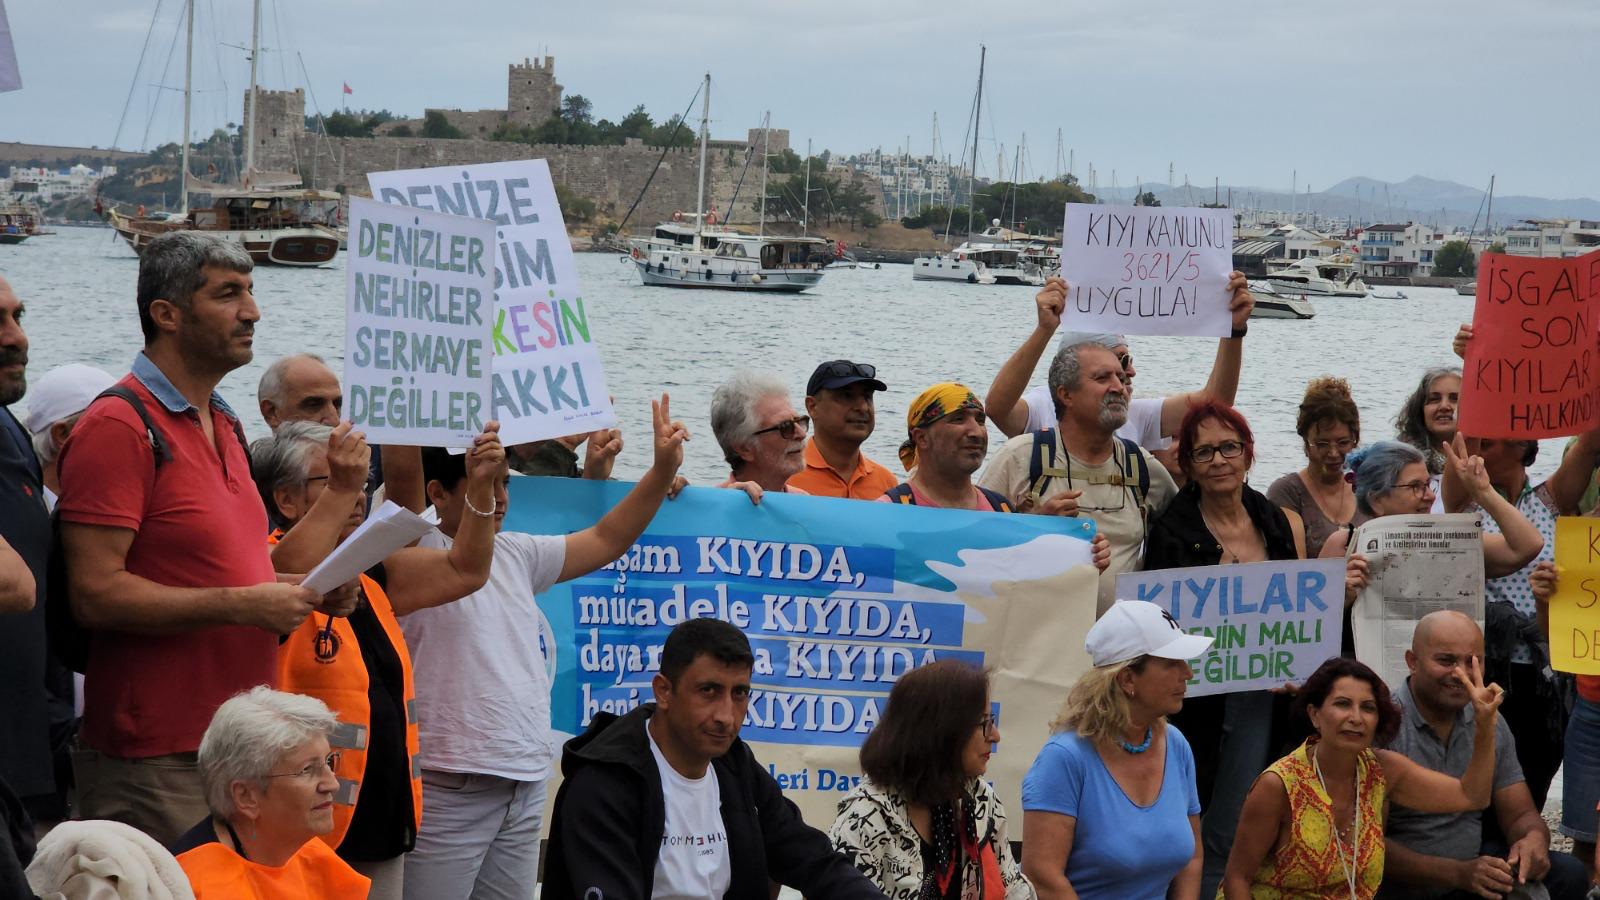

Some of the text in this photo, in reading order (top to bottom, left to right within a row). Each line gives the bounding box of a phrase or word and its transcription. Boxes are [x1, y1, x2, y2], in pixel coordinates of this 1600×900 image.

[358, 216, 486, 278] DENİZLER
[1087, 213, 1225, 250] KIYI KANUNU
[1121, 250, 1200, 283] 3621/5
[354, 268, 482, 326] NEHİRLER
[492, 290, 592, 356] KESİN
[1076, 286, 1197, 318] UYGULA!
[353, 326, 482, 378] SERMAYE
[1521, 305, 1589, 349] SON
[350, 376, 484, 433] DEĞİLLER
[491, 362, 590, 421] AKKI
[600, 536, 866, 588] şam KIYIDA,
[579, 583, 932, 644] mücadele KIYIDA,
[1259, 618, 1322, 646] MALI
[1187, 647, 1296, 685] EĞİLDİR
